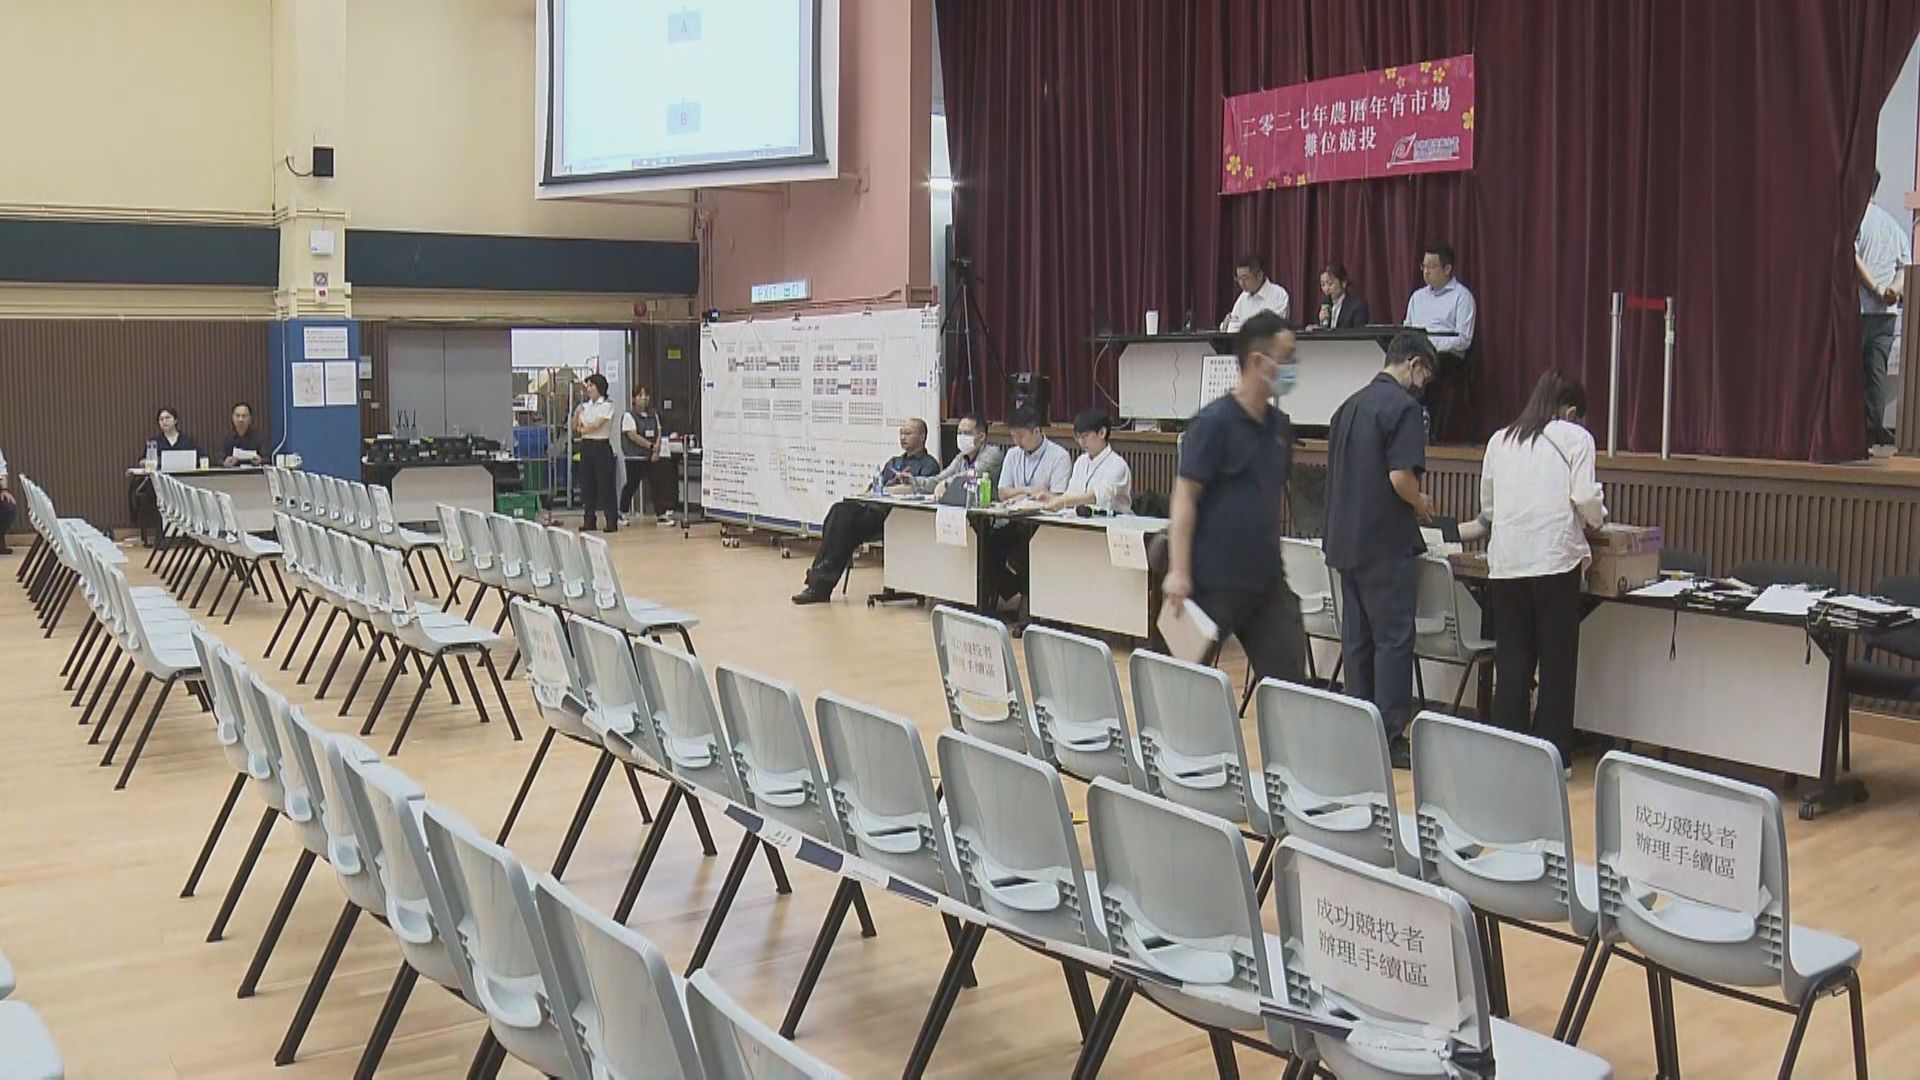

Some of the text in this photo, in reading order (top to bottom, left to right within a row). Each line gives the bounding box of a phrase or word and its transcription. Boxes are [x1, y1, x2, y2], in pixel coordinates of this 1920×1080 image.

[1304, 126, 1377, 158] 攤位競投
[757, 282, 799, 300] EXIT 出口
[1635, 803, 1737, 850] 成功競投者
[1636, 831, 1736, 879] 辦理手續區
[1316, 897, 1425, 954] 成功競投者
[1318, 928, 1429, 987] 辦理手續區
